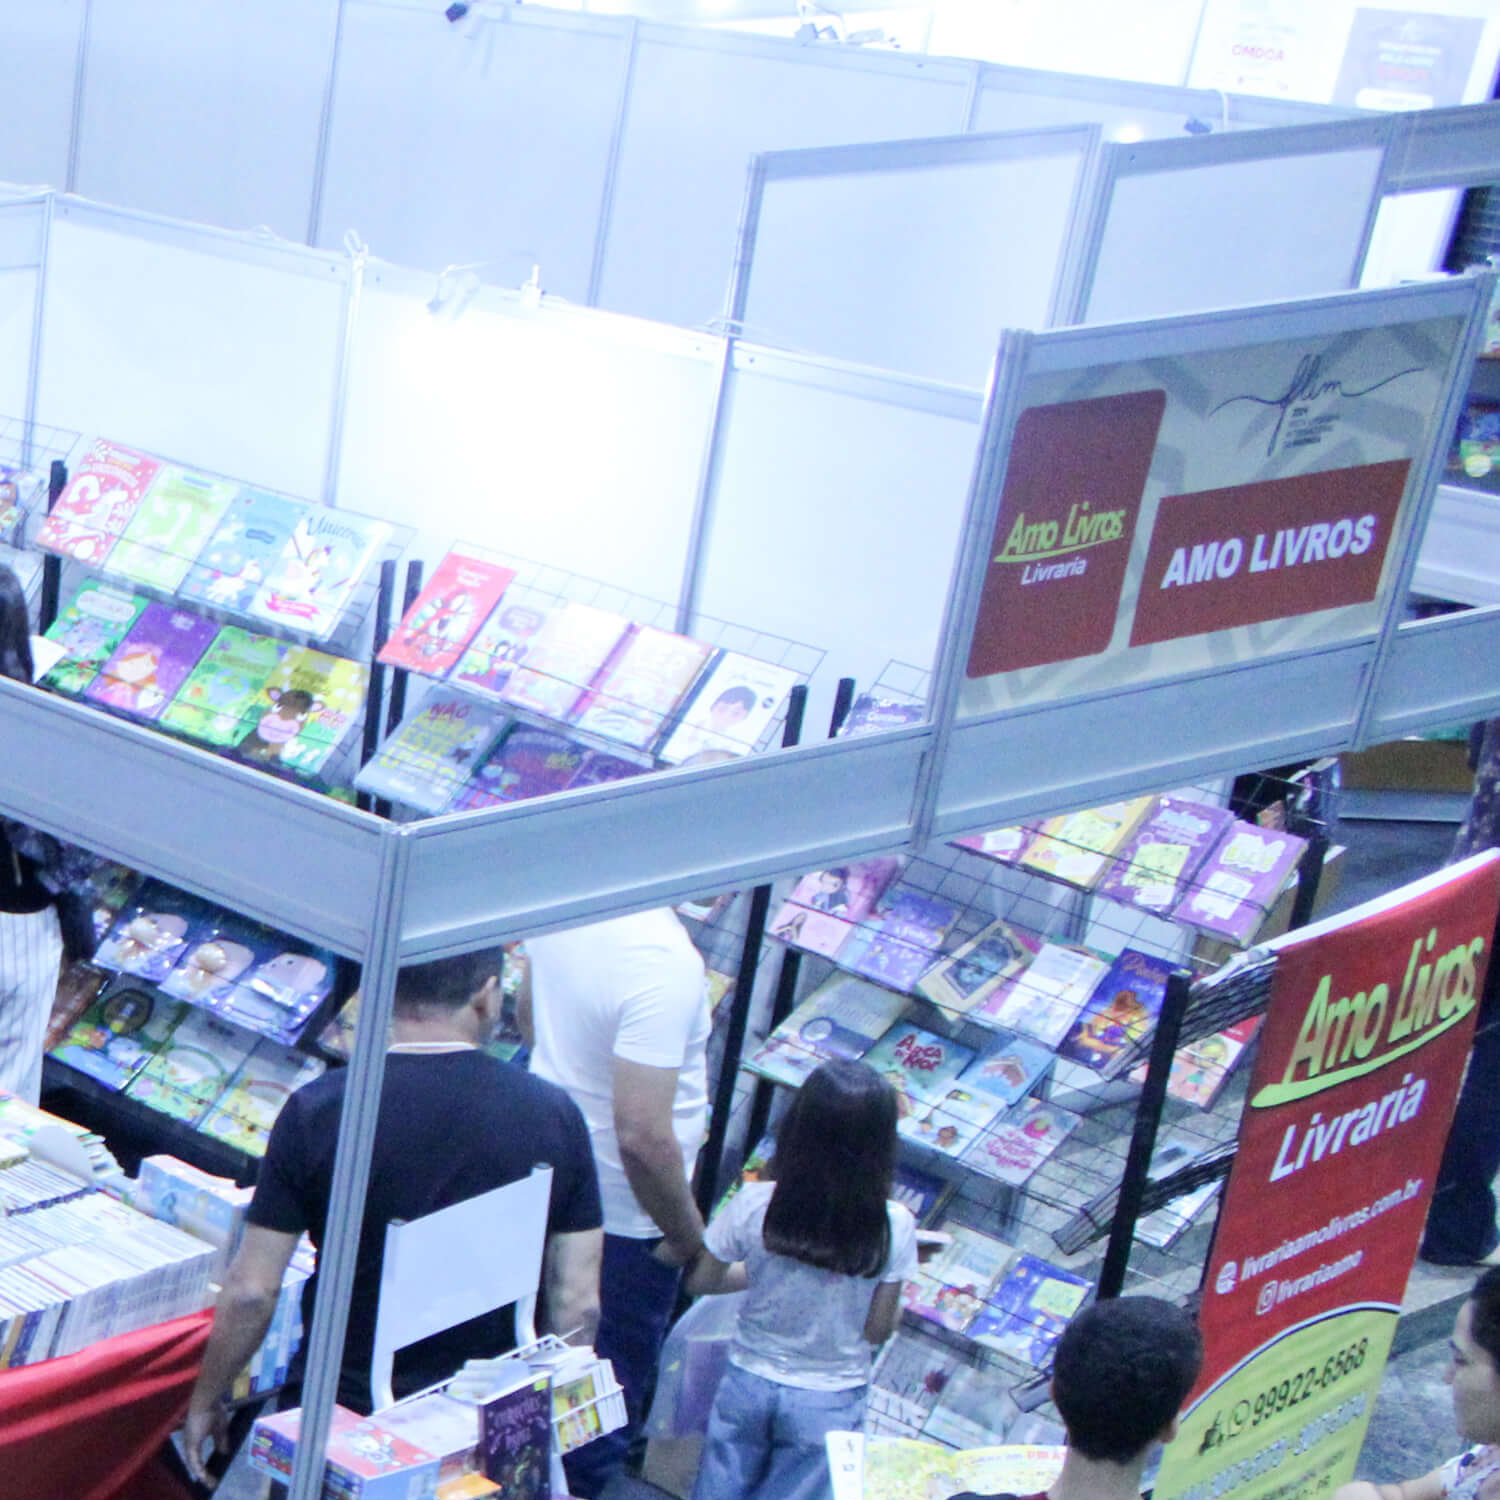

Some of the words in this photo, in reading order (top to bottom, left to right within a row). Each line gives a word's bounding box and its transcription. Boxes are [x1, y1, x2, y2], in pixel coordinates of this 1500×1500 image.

[1003, 511, 1058, 554] Amo
[1062, 500, 1127, 543] Livros
[1160, 537, 1244, 590] AMO
[1248, 513, 1378, 574] LIVROS
[1021, 556, 1089, 586] Livraria
[1281, 974, 1390, 1085] Amo
[1386, 927, 1486, 1044] Livros
[1269, 1072, 1429, 1183] Livraria
[1277, 1250, 1364, 1304] livrariaamo
[1251, 1337, 1369, 1428] 99922-6568
